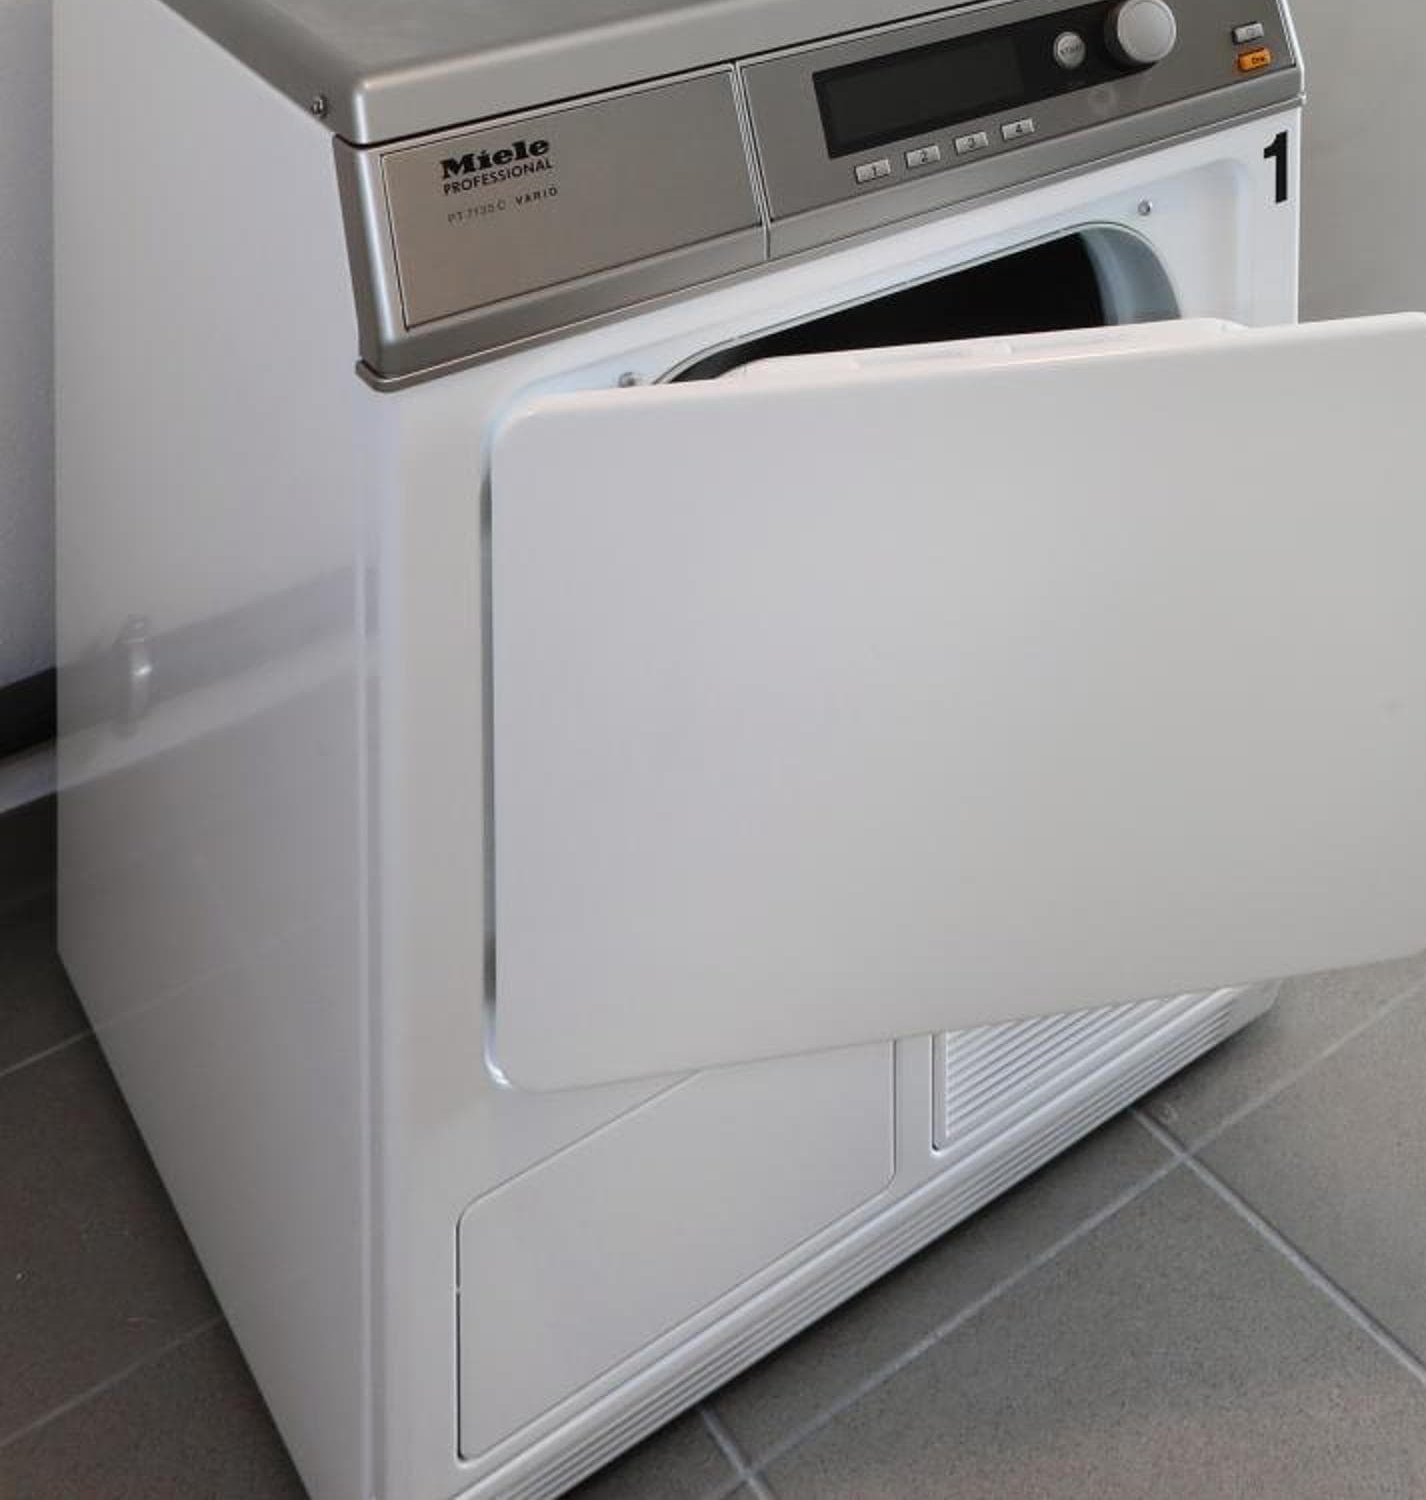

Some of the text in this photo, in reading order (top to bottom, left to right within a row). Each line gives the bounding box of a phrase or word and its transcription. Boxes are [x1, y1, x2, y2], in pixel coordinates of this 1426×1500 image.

[441, 139, 549, 180] Miele
[443, 159, 553, 196] PROFESSIONAL
[1264, 130, 1288, 204] 1
[515, 186, 558, 205] VARIO
